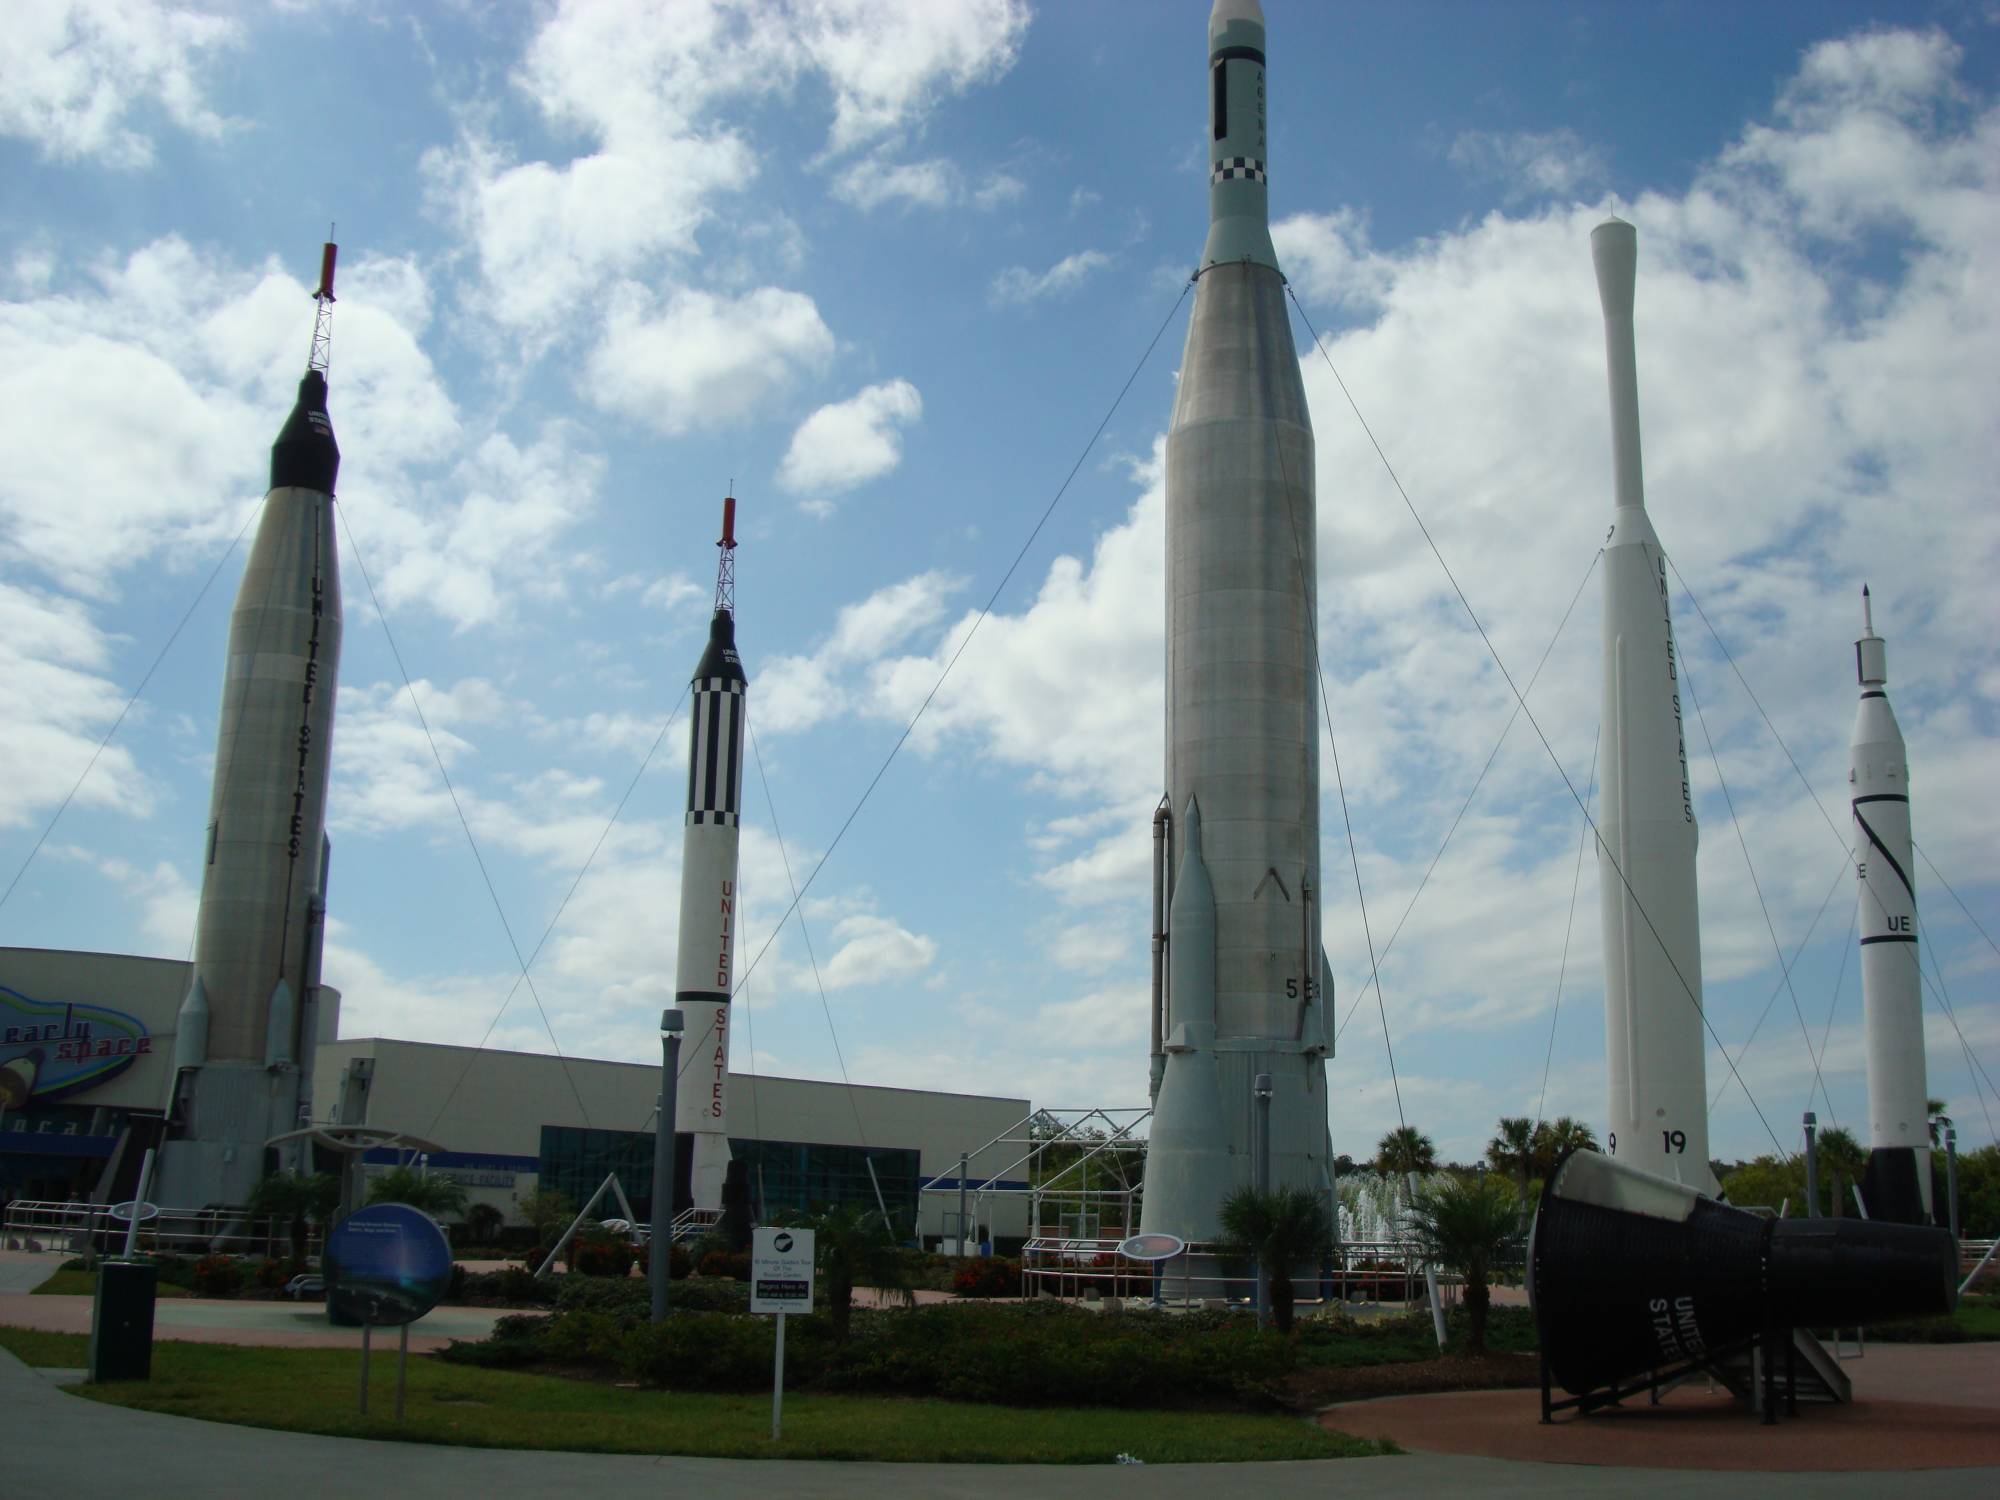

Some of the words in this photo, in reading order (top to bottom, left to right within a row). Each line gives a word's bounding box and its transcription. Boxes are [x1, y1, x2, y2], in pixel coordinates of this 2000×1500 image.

[303, 577, 323, 703] UNITED
[1657, 556, 1678, 681] UNITED
[1671, 694, 1693, 824] STATES
[287, 725, 311, 858] STATES
[717, 880, 733, 988] UNITED
[1887, 916, 1911, 932] UE
[56, 1037, 153, 1063] space
[711, 1008, 728, 1118] STATES
[1662, 1130, 1687, 1154] 19
